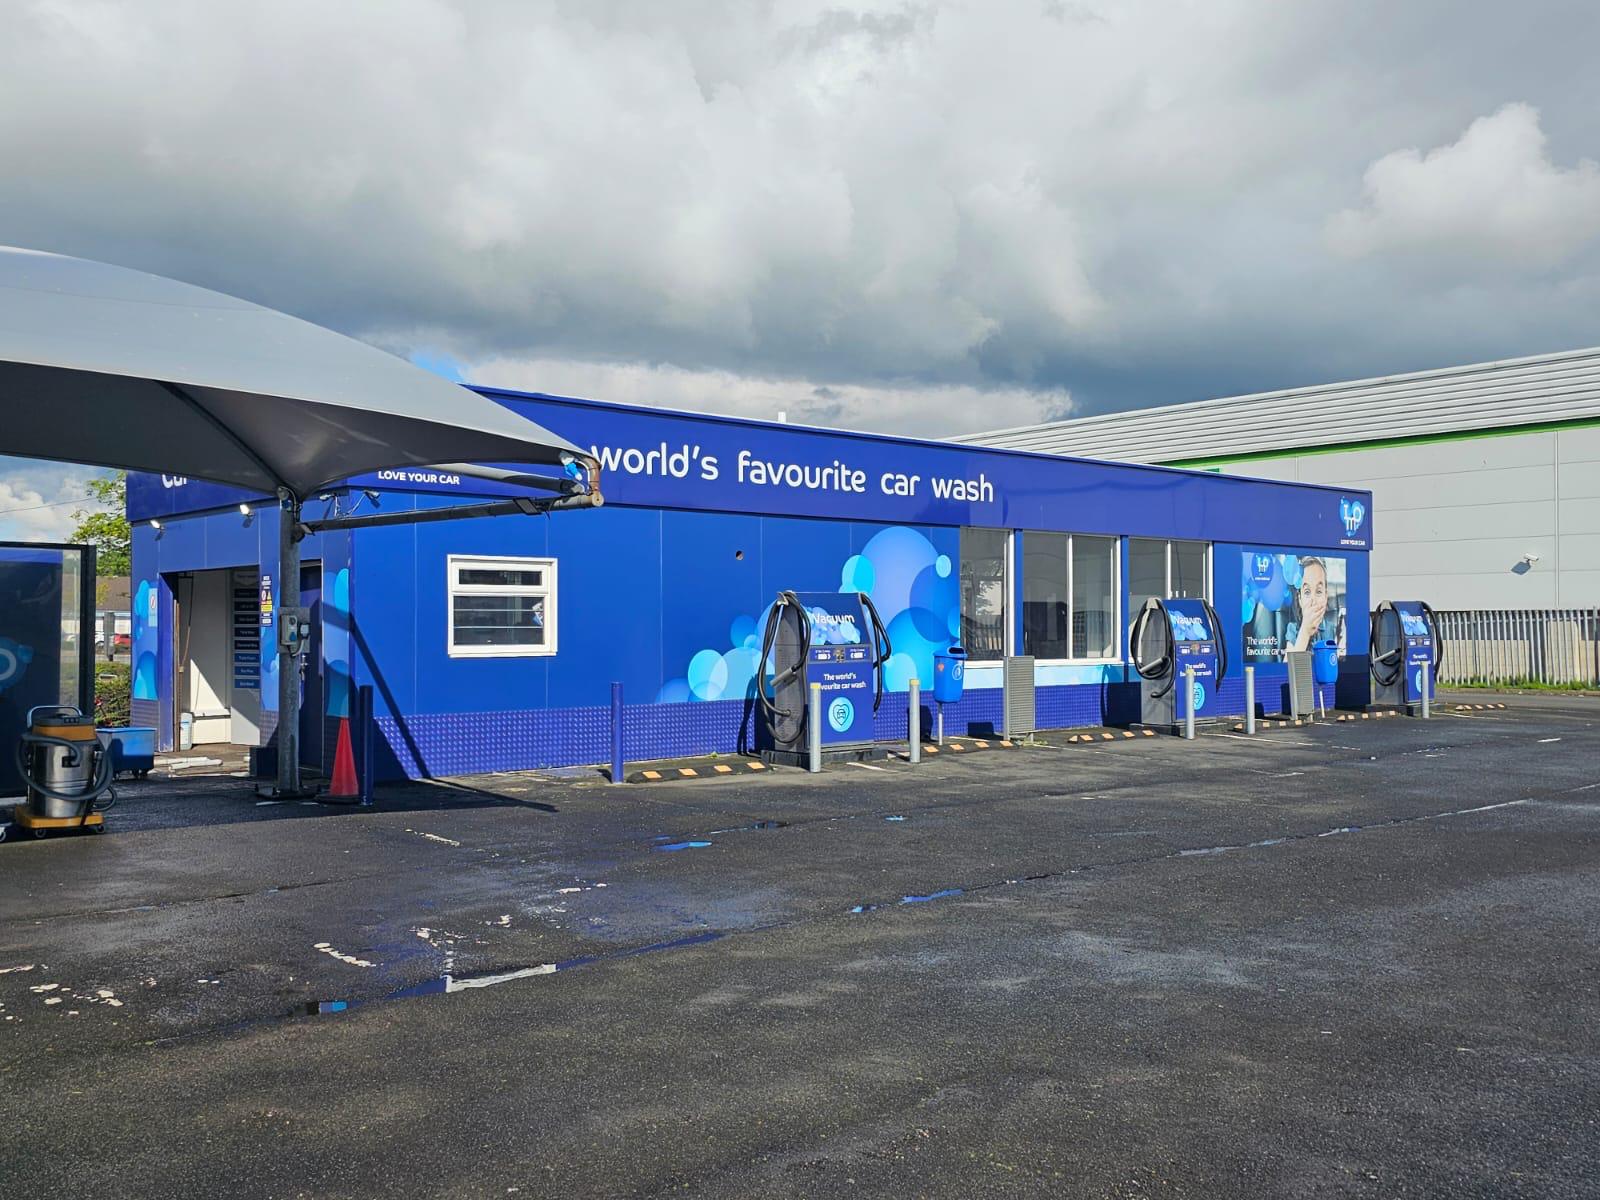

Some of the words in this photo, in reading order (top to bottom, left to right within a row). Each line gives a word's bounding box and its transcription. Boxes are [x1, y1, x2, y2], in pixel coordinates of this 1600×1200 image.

[591, 442, 719, 480] world's
[738, 450, 866, 492] favourite
[880, 472, 921, 496] car
[931, 473, 994, 502] wash
[378, 470, 406, 481] LOVE
[408, 473, 437, 483] YOUR
[439, 475, 460, 485] CAR
[813, 613, 855, 624] Vacuum
[1246, 636, 1257, 645] The
[1246, 646, 1270, 656] favourite
[823, 673, 834, 681] The
[835, 672, 857, 680] world's
[820, 682, 841, 690] vourite
[851, 681, 867, 689] wash
